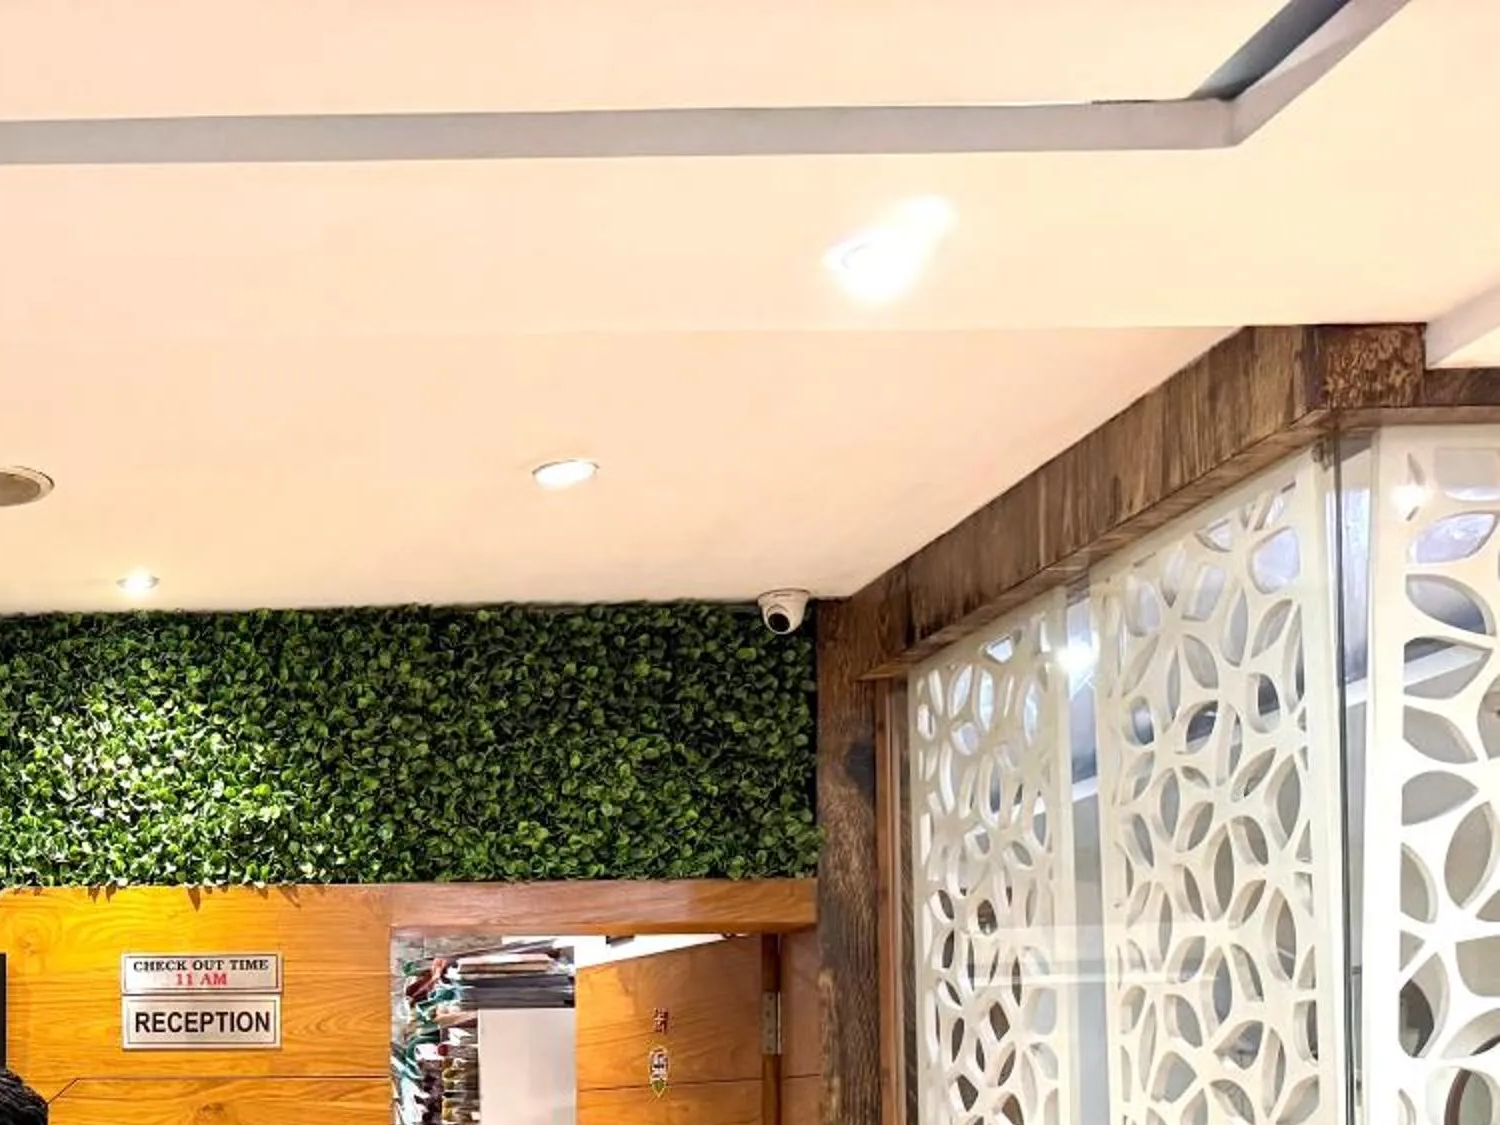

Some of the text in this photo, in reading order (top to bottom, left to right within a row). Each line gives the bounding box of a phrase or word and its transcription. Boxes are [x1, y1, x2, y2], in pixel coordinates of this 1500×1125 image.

[133, 959, 269, 972] CHECK OUT TIME
[176, 973, 229, 986] 11 AM
[135, 1011, 270, 1033] RECEPTION
